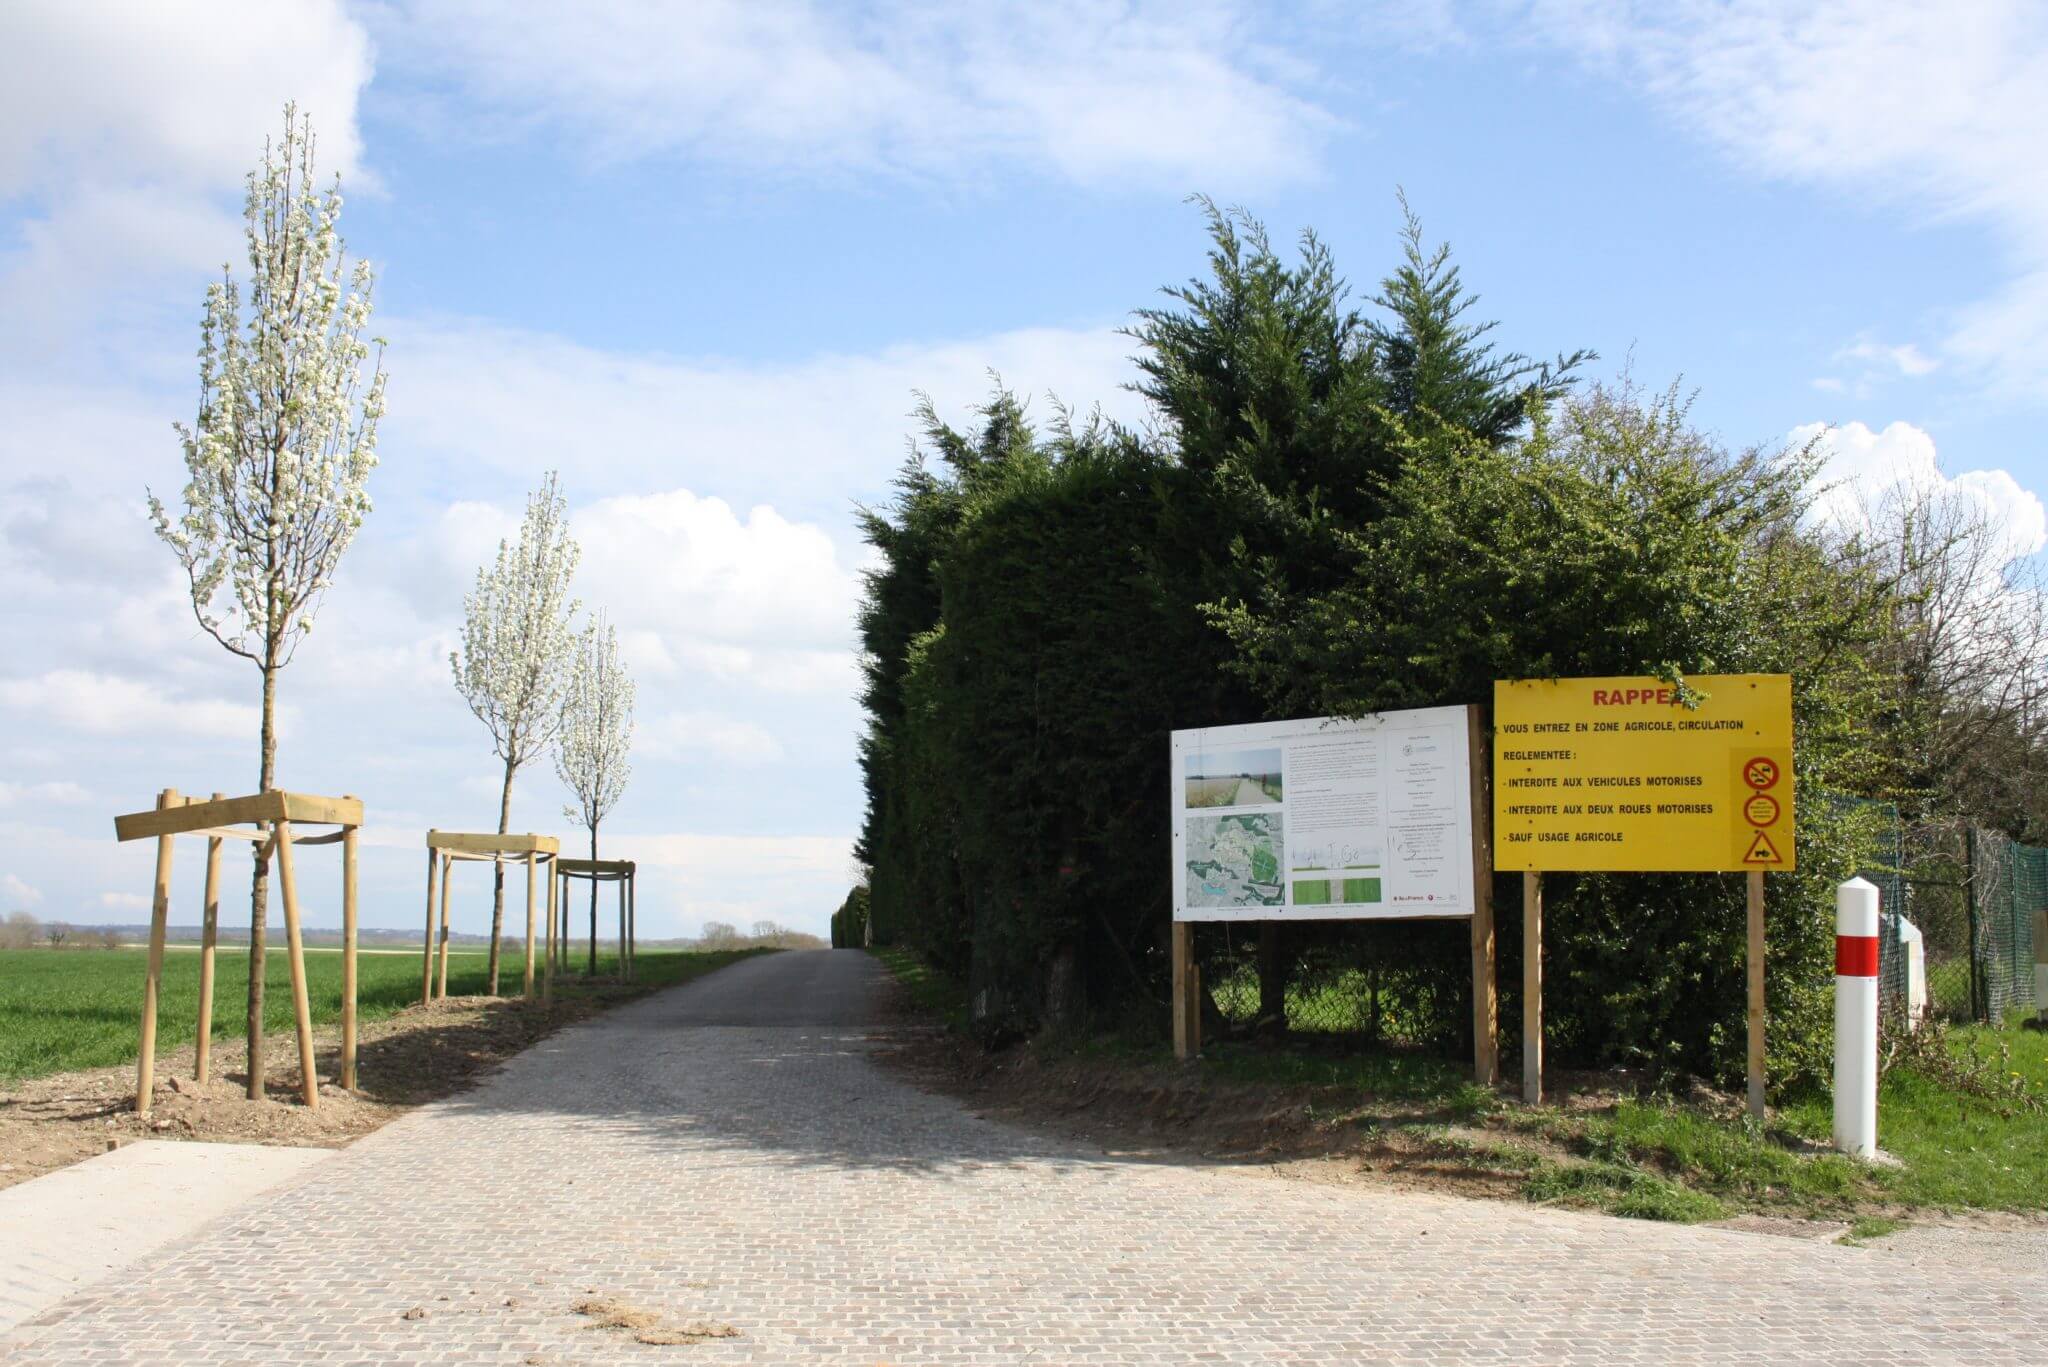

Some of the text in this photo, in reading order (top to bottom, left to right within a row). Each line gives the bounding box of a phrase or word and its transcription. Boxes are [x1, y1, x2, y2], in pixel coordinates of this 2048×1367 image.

[1503, 720, 1744, 734] VOUS ENTREZ EN ZONE AGRICOLE, CIRCULATION
[1503, 750, 1571, 760] REGLEMENTEE
[1508, 777, 1558, 787] INTERDITE
[1562, 777, 1582, 787] AUX
[1587, 777, 1641, 787] VEHICULES
[1646, 776, 1703, 786] MOTORISES
[1508, 805, 1558, 814] INTERDITE
[1562, 805, 1582, 814] AUX
[1587, 804, 1614, 814] DEUX
[1619, 804, 1652, 814] ROUES
[1657, 804, 1713, 814] MOTORISES
[1508, 832, 1533, 842] SAUF
[1538, 832, 1570, 842] USAGE
[1575, 832, 1623, 842] AGRICOLE
